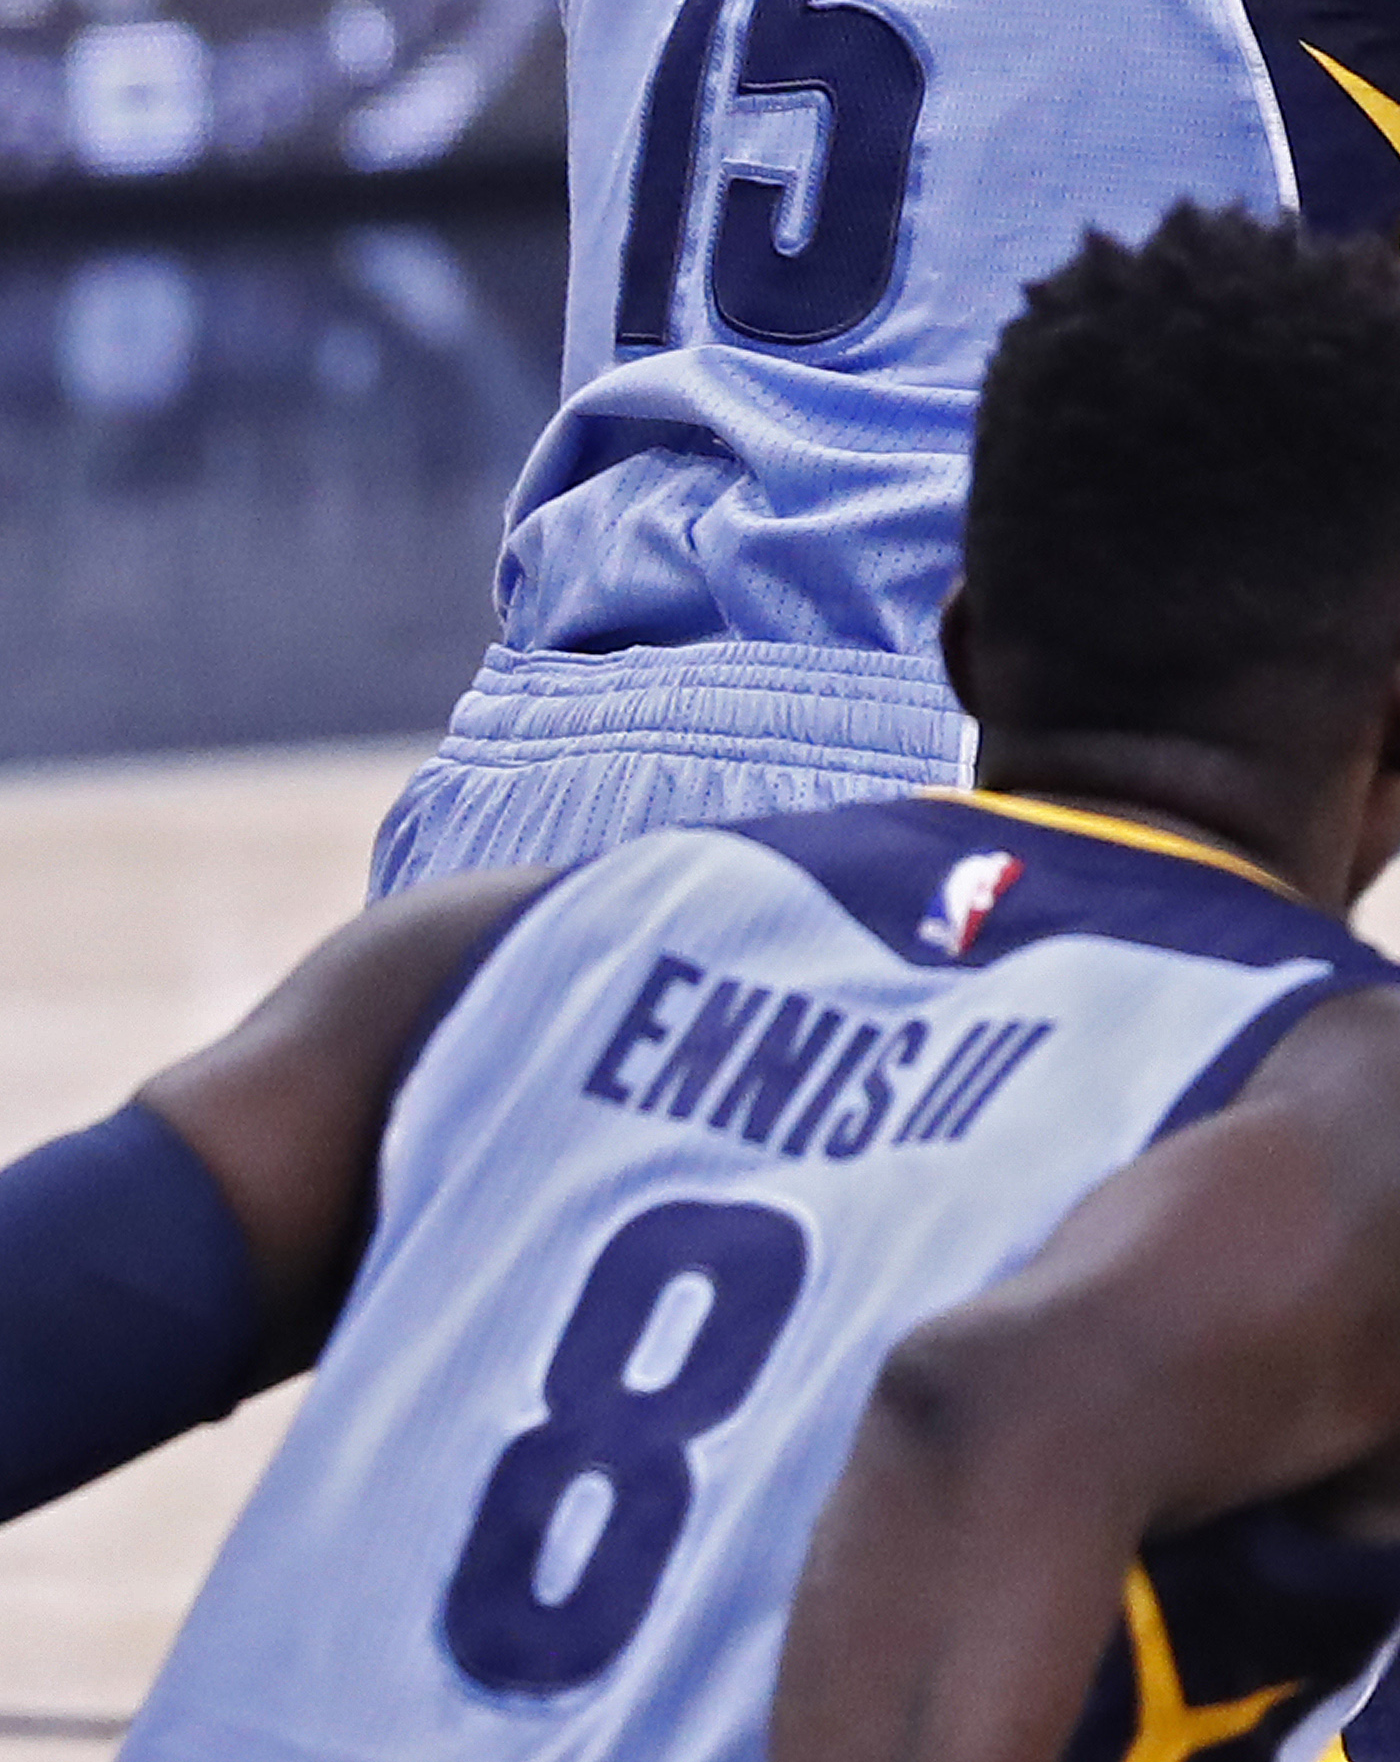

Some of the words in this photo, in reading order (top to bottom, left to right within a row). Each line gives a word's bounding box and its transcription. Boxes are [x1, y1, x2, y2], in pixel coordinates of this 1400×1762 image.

[582, 950, 928, 1163] ENNIS
[890, 1018, 1056, 1147] III
[443, 1198, 811, 1697] 8
